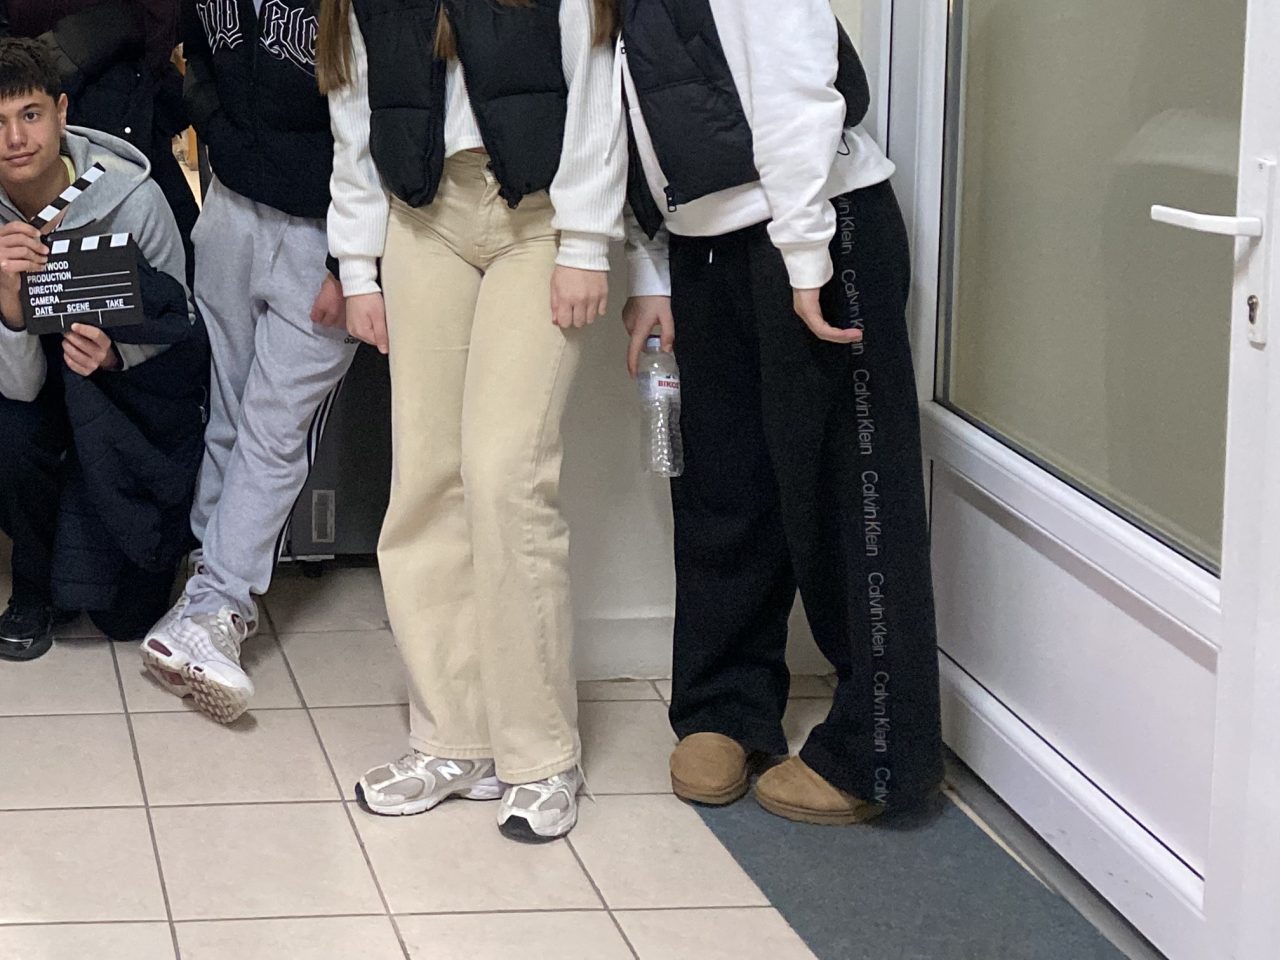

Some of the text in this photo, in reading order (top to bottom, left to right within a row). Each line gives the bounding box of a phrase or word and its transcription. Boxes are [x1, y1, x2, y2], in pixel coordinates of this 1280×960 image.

[839, 216, 856, 255] Klein
[27, 271, 72, 284] PRODUCTION
[28, 284, 64, 295] DIRECTOR
[841, 268, 864, 320] Calvin
[30, 295, 60, 306] CAMERA
[34, 298, 124, 316] DATE SCENE TAKE
[853, 368, 876, 455] Calvin Klein
[861, 470, 882, 557] Calvin Klein
[867, 572, 888, 657] Calvin Klein
[873, 671, 891, 753] Calvin Klein
[874, 767, 891, 804] Calv
